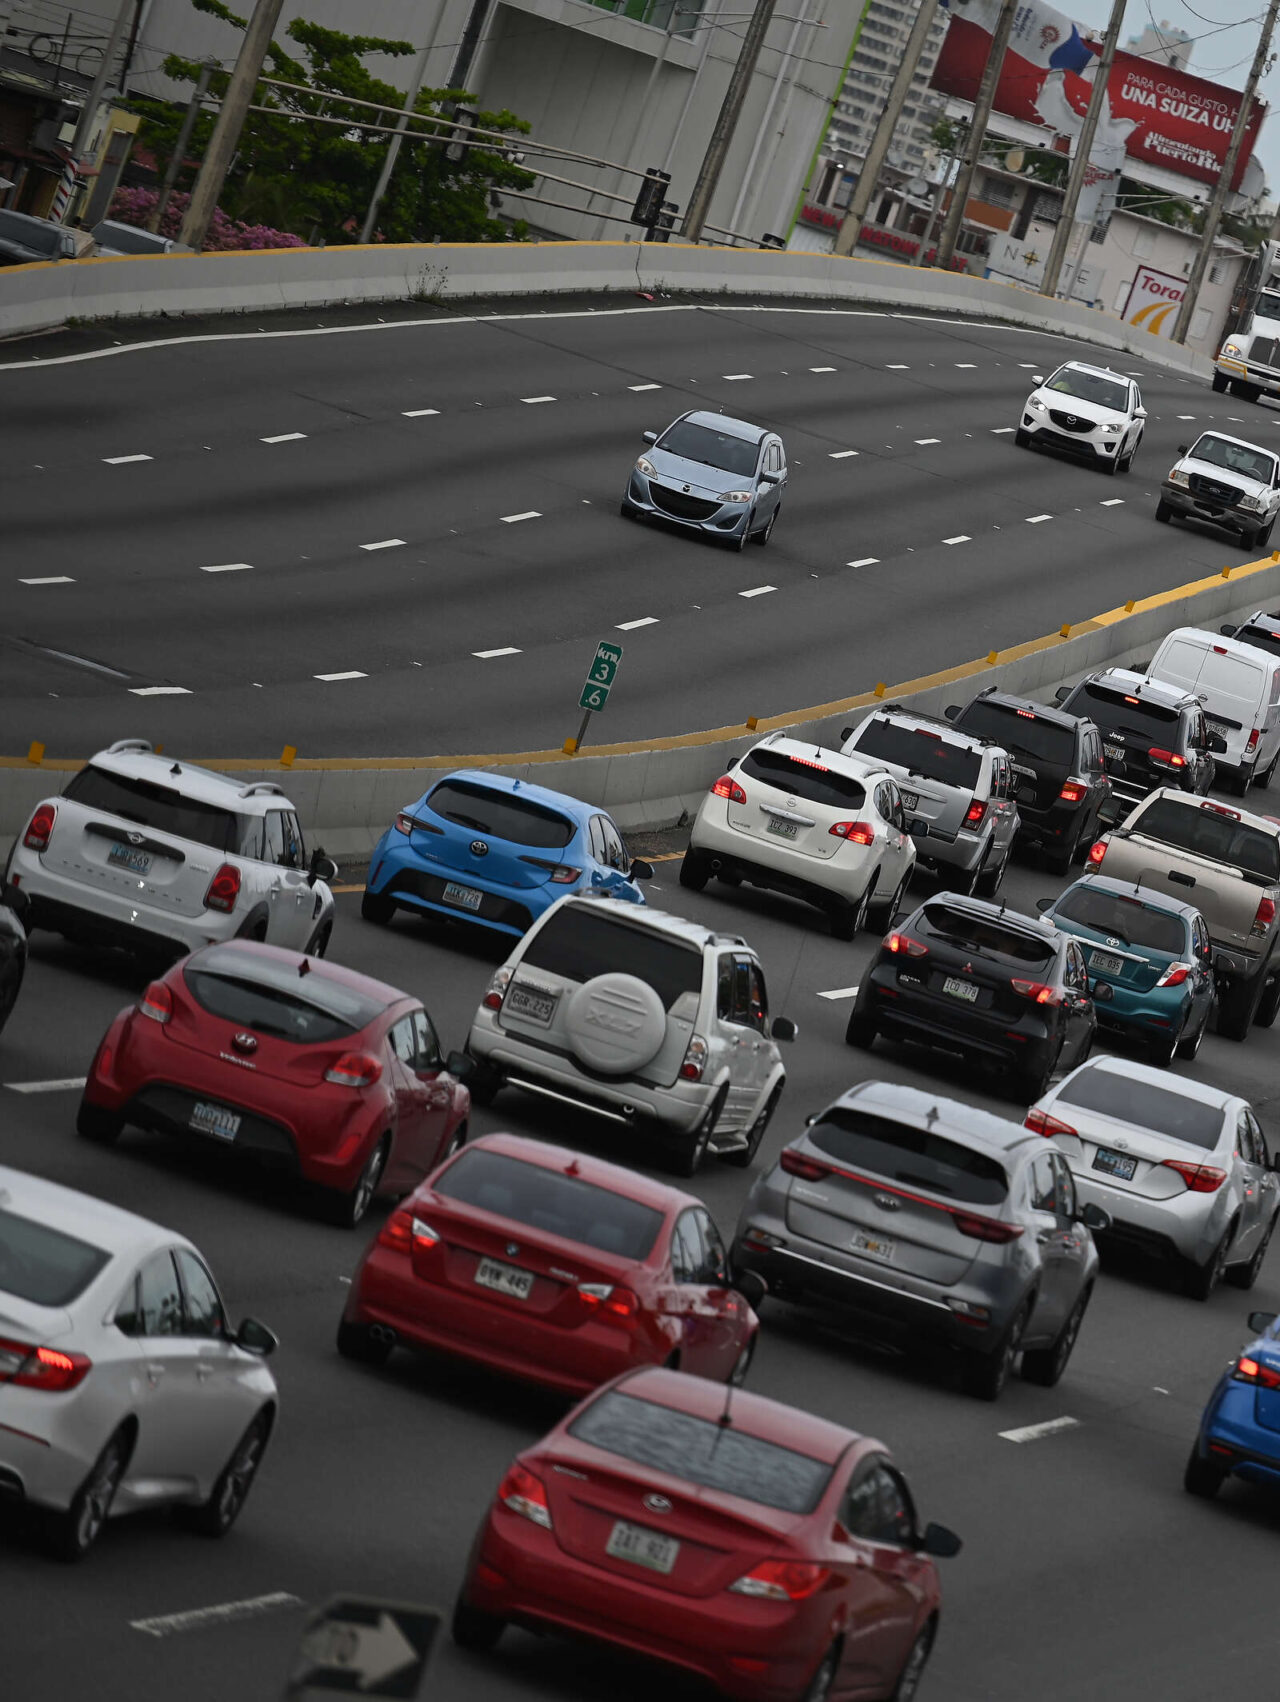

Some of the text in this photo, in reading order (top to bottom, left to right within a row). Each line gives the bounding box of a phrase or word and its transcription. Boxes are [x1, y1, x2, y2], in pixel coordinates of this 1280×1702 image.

[1127, 73, 1154, 91] PARA
[1156, 83, 1186, 101] CADA
[1121, 84, 1251, 135] UNA SUIZA UH
[597, 647, 618, 663] km
[595, 664, 609, 681] 3
[1109, 732, 1125, 742] Jeep
[784, 824, 798, 836] 393
[1092, 953, 1105, 966] IEC
[962, 985, 977, 998] 378
